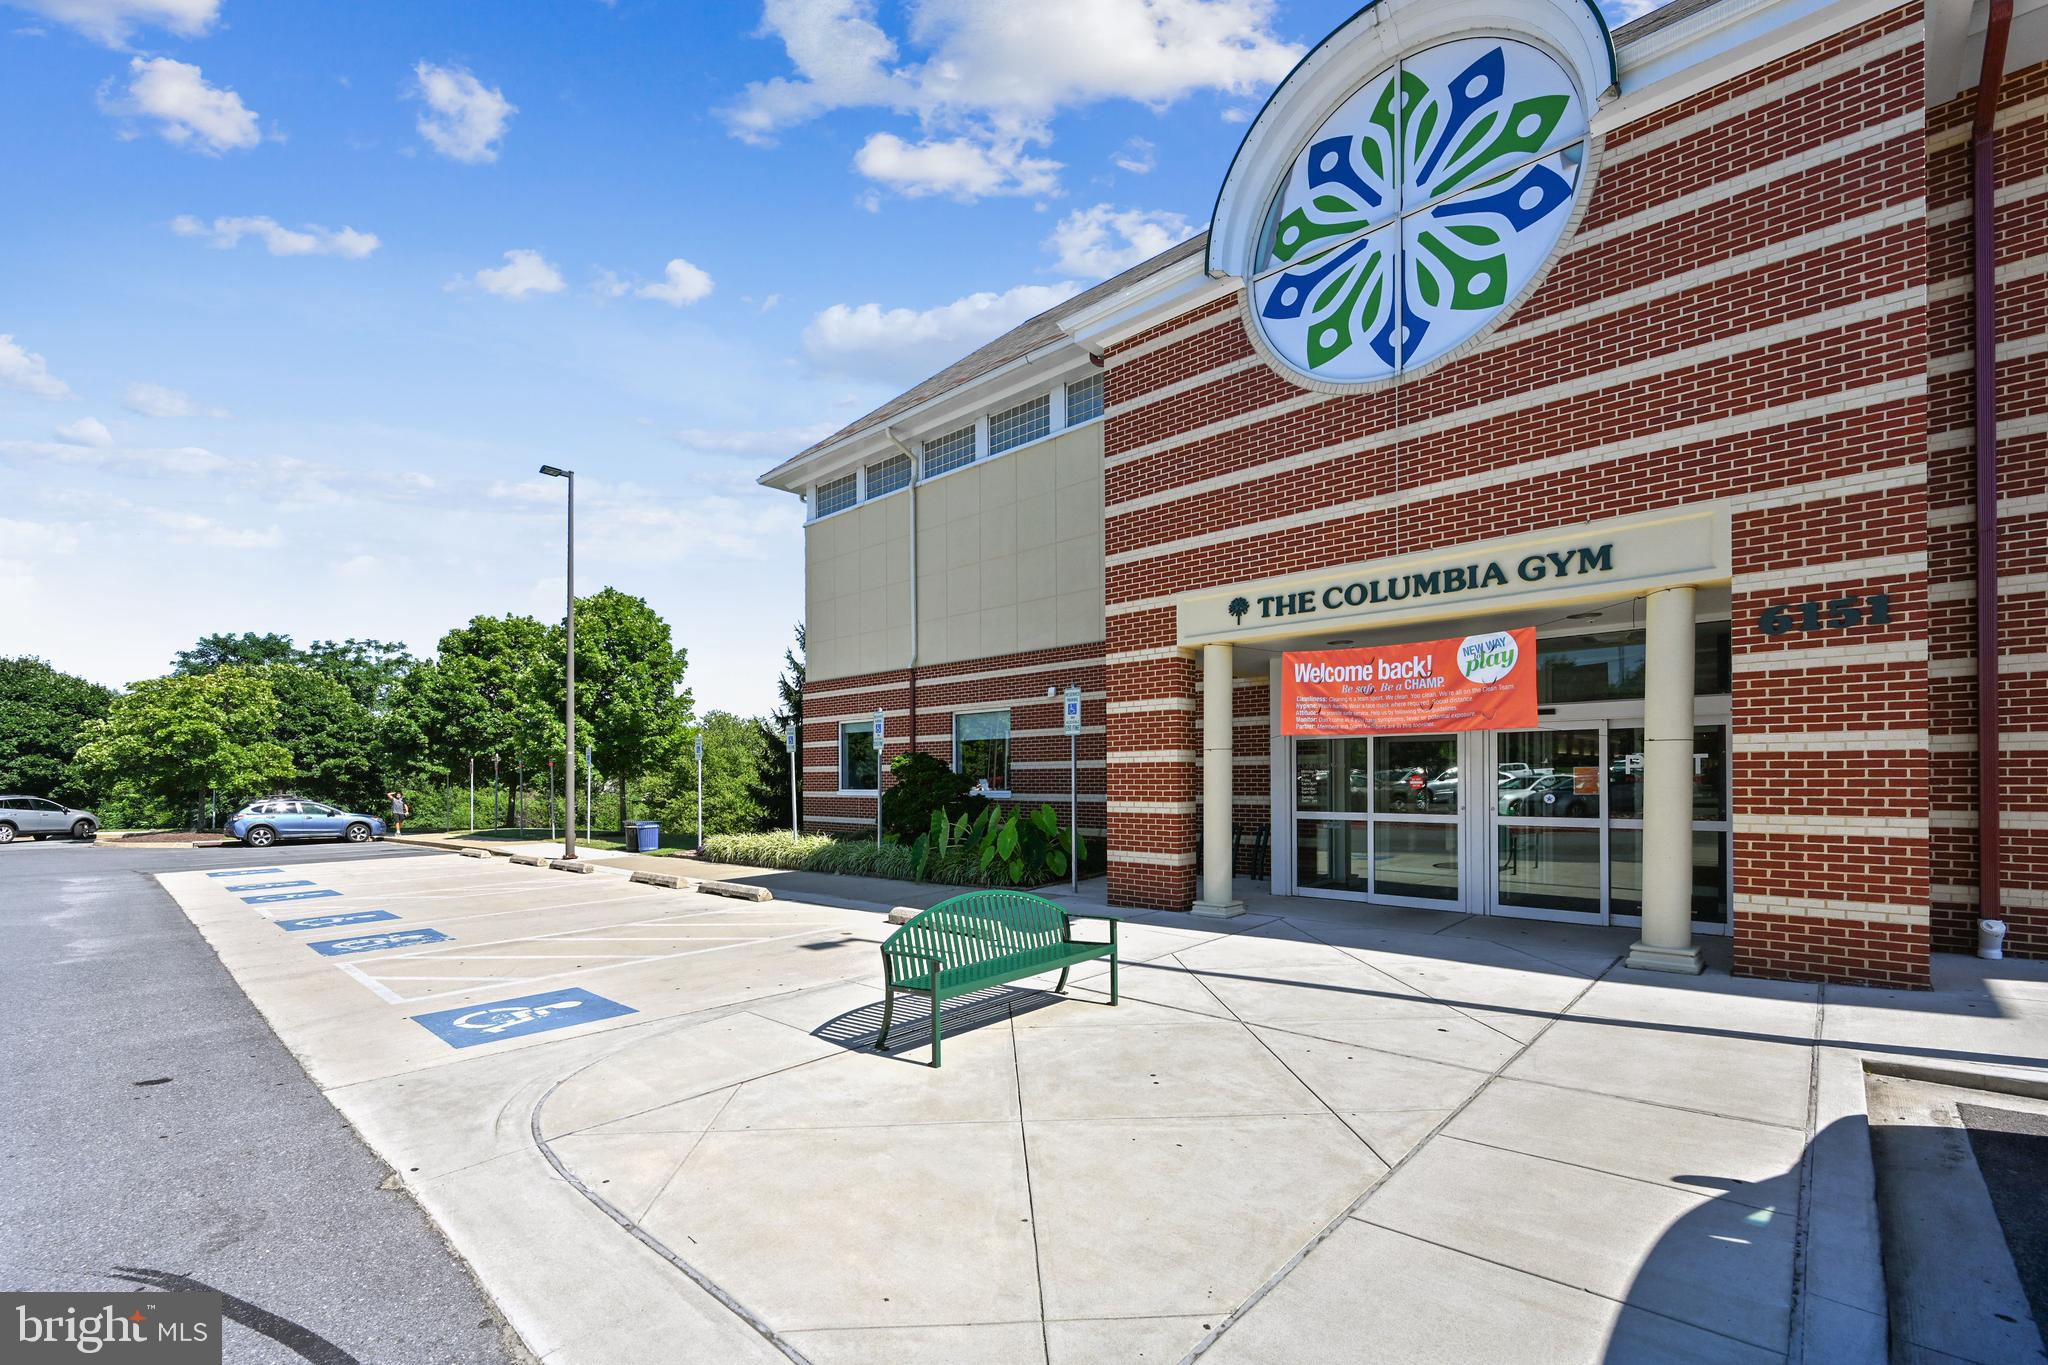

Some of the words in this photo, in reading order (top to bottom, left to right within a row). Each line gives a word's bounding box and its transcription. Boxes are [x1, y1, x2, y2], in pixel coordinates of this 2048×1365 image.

[1257, 589, 1316, 617] THE
[1322, 562, 1509, 610] COLUMBIA
[1518, 544, 1614, 581] GYM
[1758, 594, 1892, 635] 6151
[1462, 643, 1484, 657] NEW
[1485, 636, 1506, 651] WAY
[1294, 662, 1373, 683] Welcome
[1378, 655, 1433, 680] back!
[1465, 649, 1515, 678] play
[1342, 685, 1353, 694] Be
[1380, 683, 1393, 692] Be
[1404, 676, 1445, 690] CHAMP.
